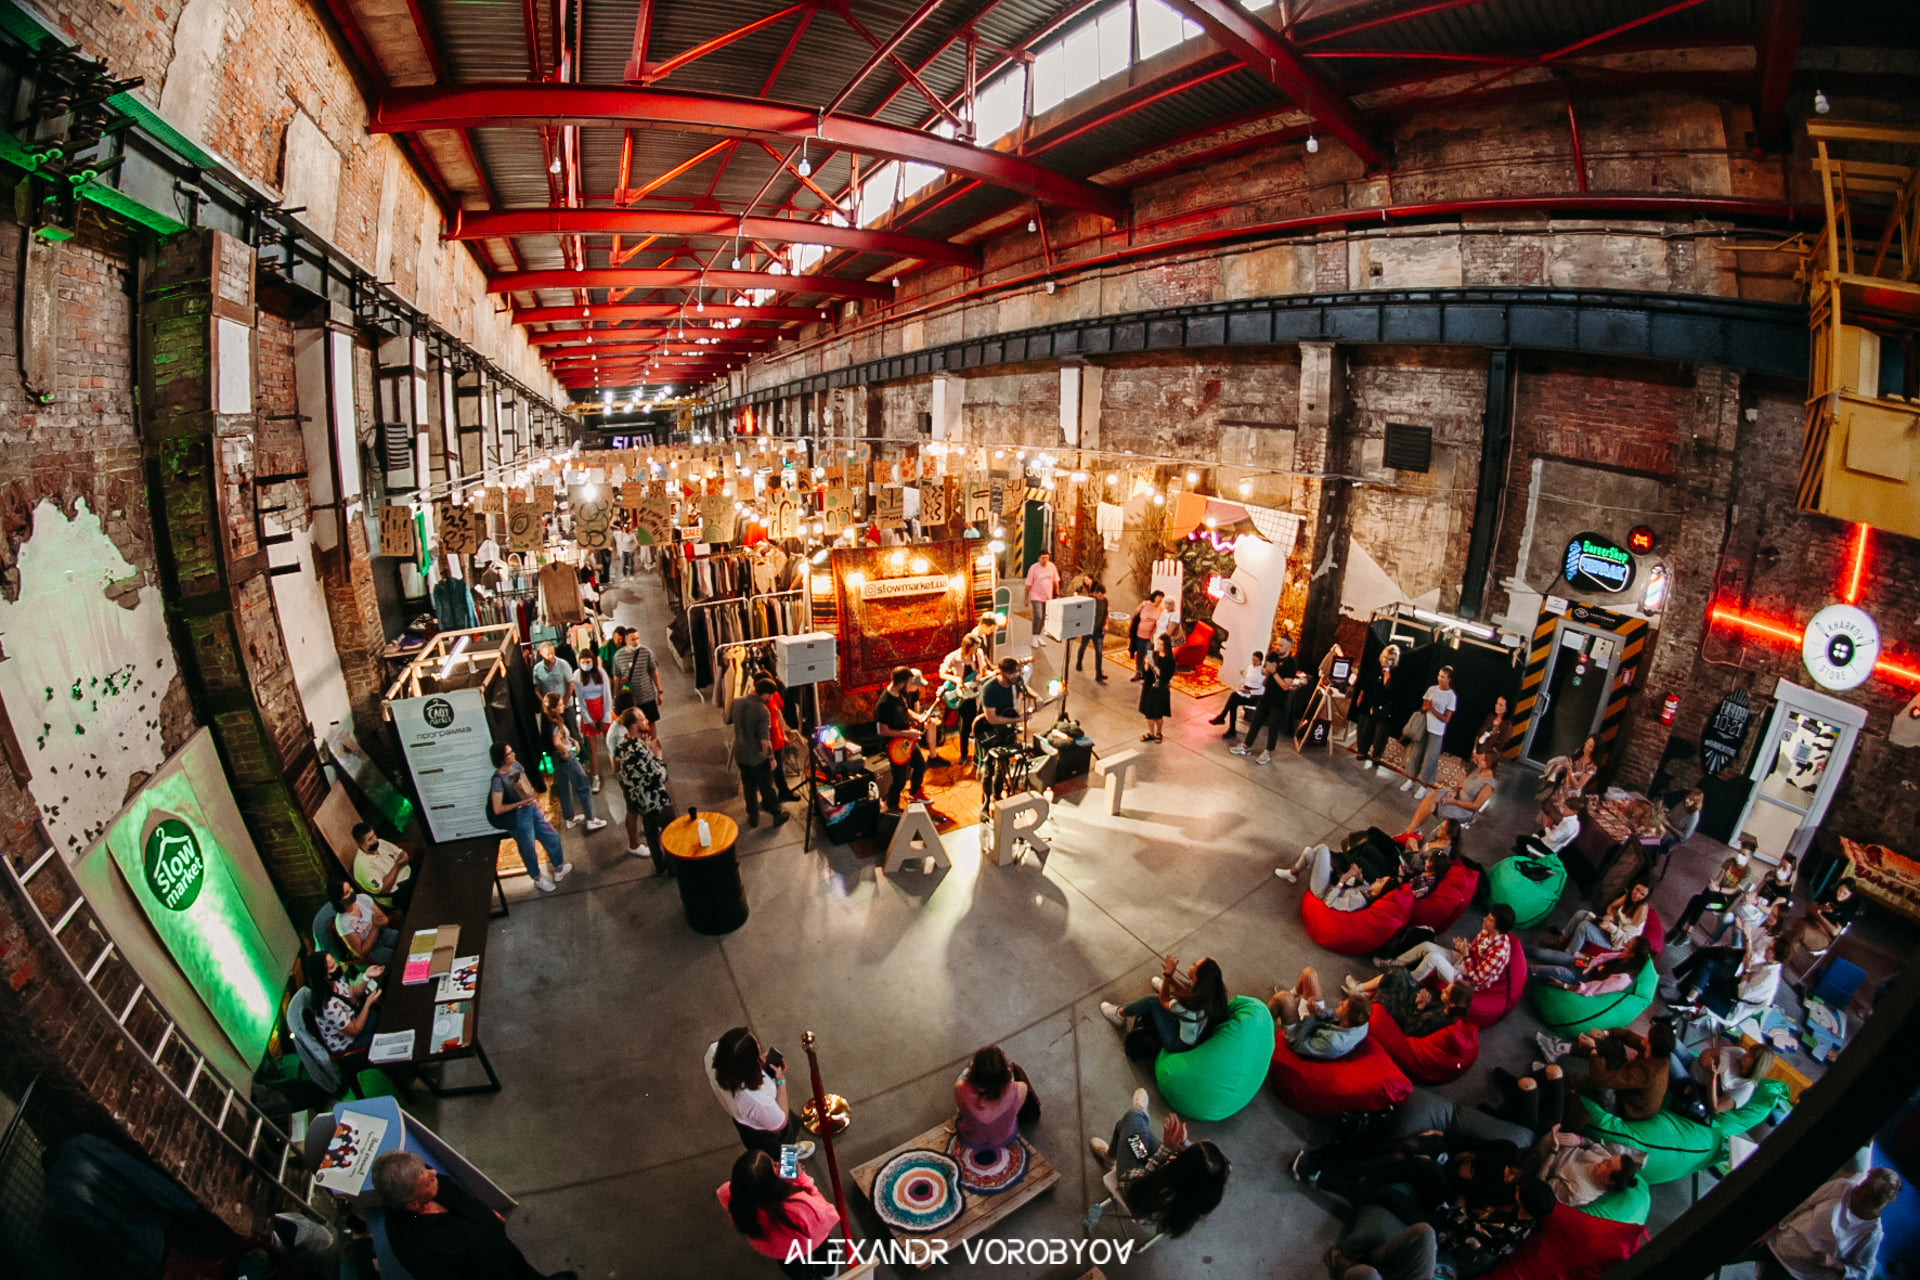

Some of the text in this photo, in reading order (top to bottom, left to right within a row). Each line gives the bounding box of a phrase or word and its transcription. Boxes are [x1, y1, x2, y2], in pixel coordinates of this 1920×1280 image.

[682, 528, 703, 538] SALE
[1828, 621, 1864, 641] KHARKOV
[1818, 664, 1847, 681] STORE
[156, 839, 197, 894] slow
[164, 856, 204, 909] market
